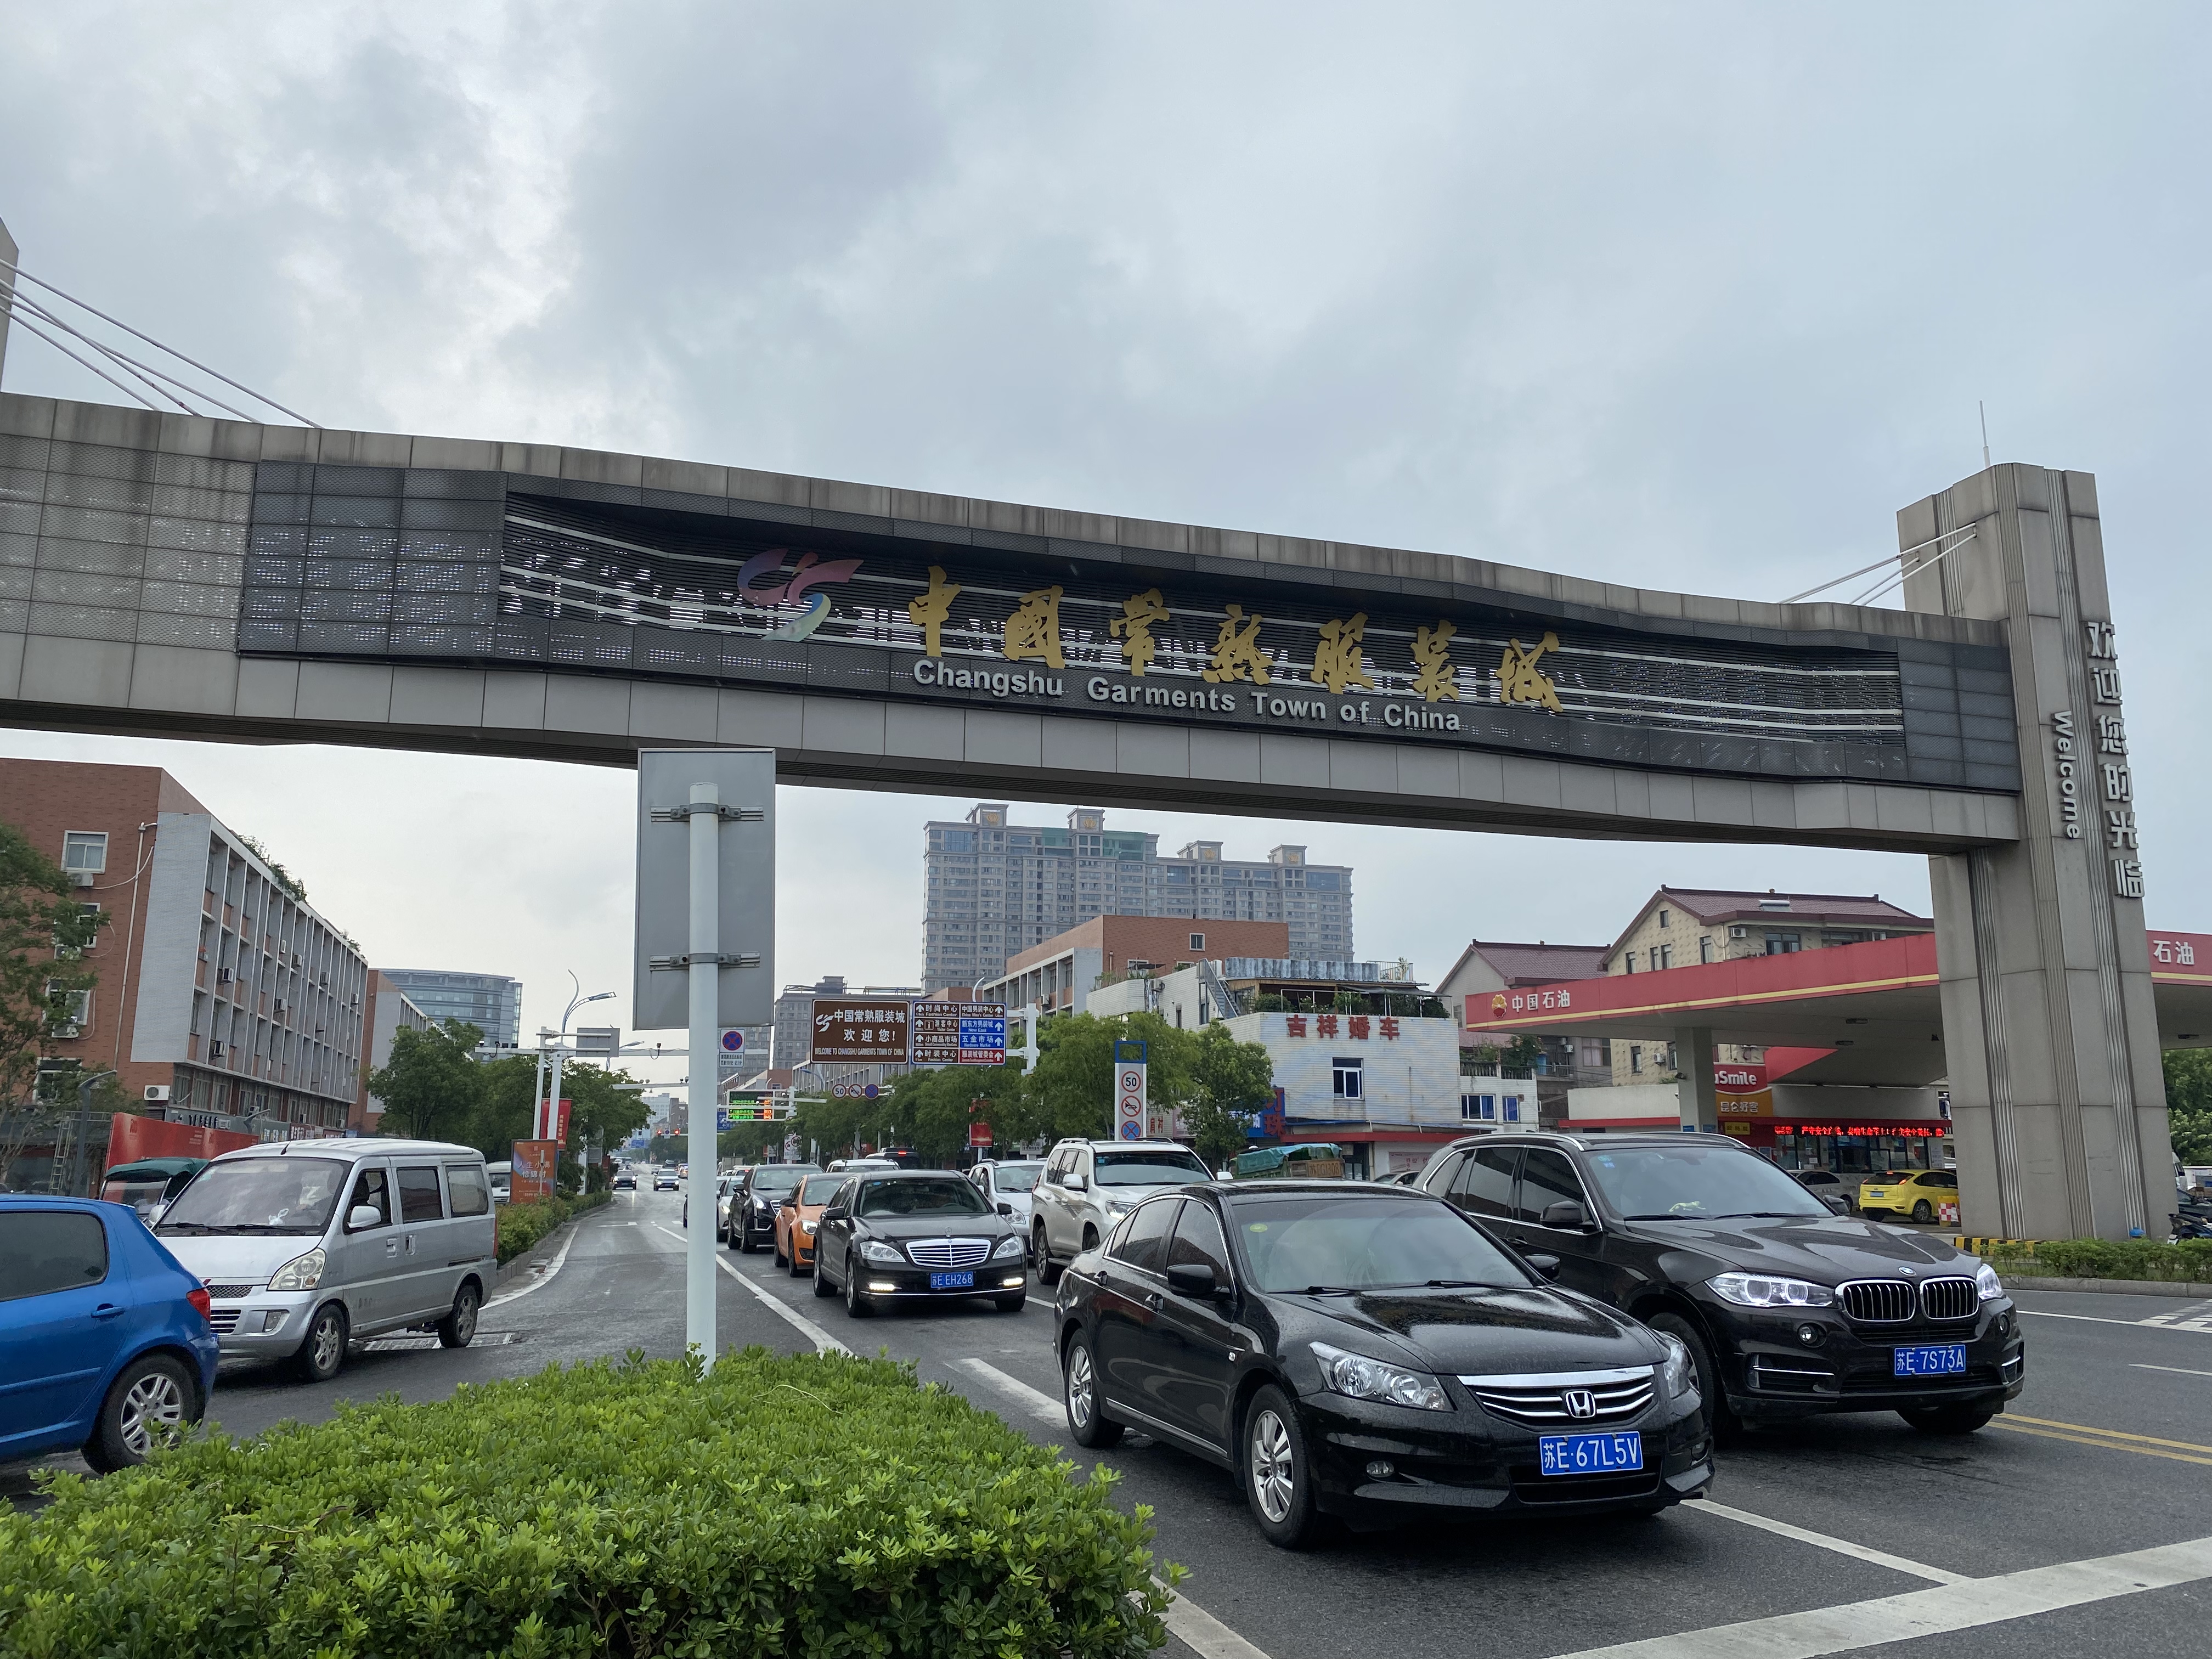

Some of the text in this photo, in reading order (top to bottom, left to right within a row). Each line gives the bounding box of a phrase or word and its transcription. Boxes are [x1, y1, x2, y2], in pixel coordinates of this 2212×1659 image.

[913, 659, 1460, 731] Changshu Garments Town of China
[2086, 621, 2145, 899] 欢迎您的光临
[2052, 710, 2081, 840] Welcome
[2153, 940, 2194, 965] 石油
[926, 1004, 958, 1013] 时尚中心
[962, 1005, 994, 1013] 中国男装中心
[1512, 990, 1571, 1012] 中国石油
[834, 1009, 905, 1023] 中国常熟服装城
[1286, 1014, 1401, 1040] 吉祥婚车
[962, 1035, 994, 1043] 五金市场
[1125, 1077, 1137, 1087] 50
[1720, 1101, 1758, 1113] 昆仑好客
